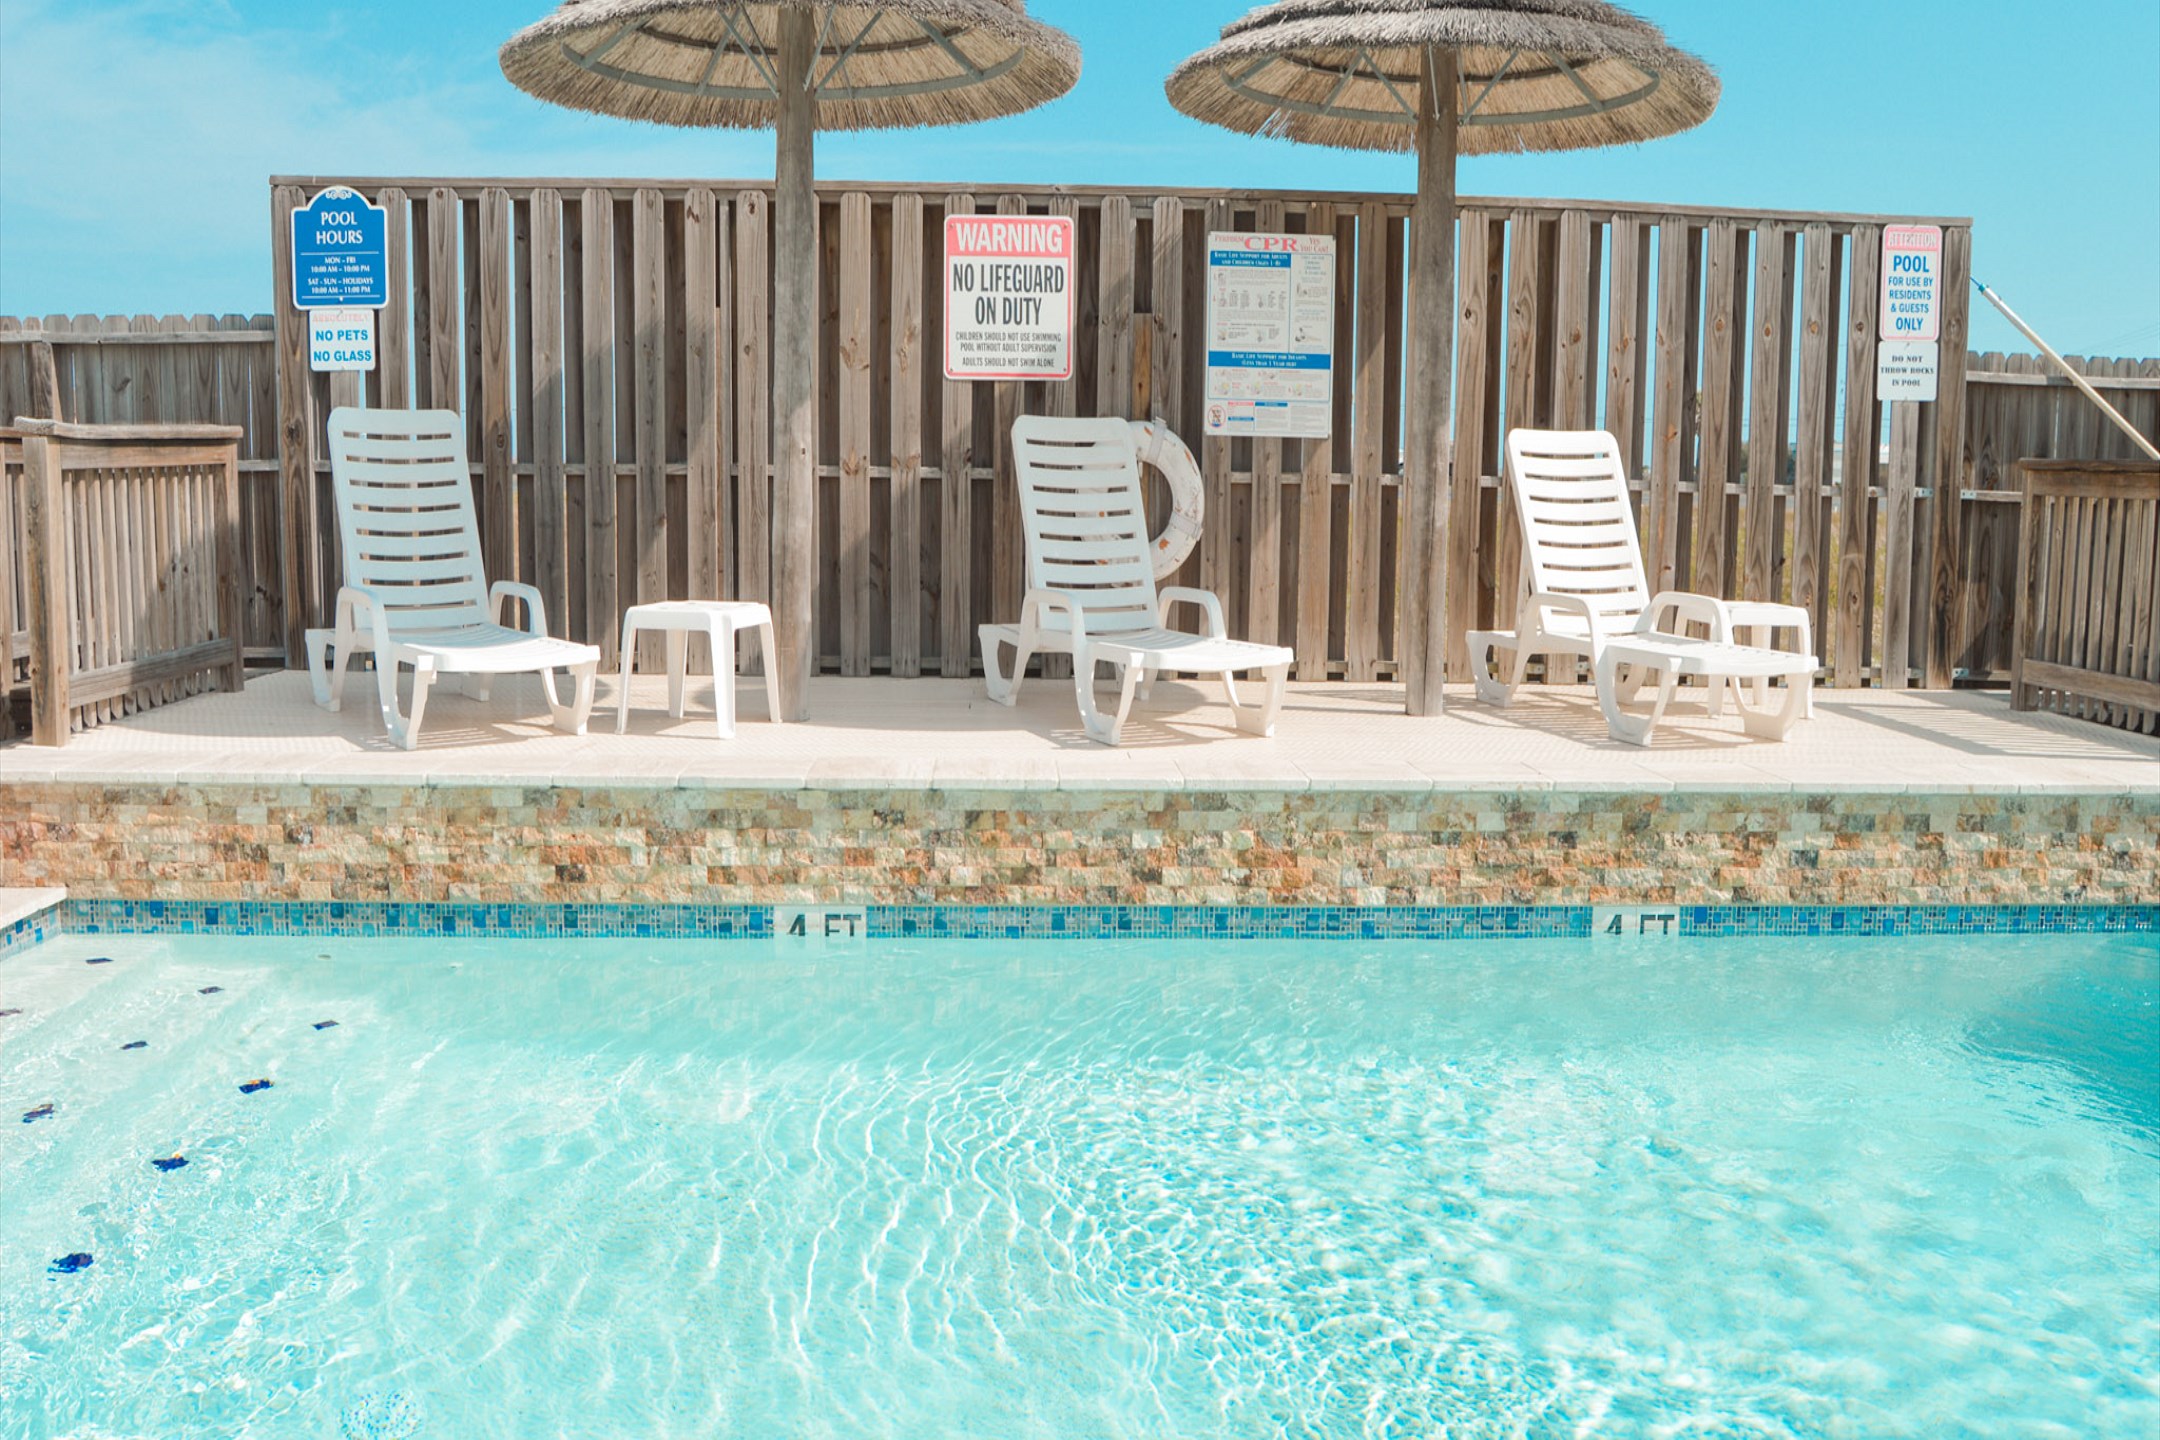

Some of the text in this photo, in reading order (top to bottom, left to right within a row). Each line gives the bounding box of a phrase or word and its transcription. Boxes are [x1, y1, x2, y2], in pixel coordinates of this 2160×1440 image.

[320, 211, 357, 226] POOL
[316, 230, 363, 244] HOURS
[955, 222, 1063, 253] WARNING
[1244, 236, 1299, 252] CPR
[1888, 232, 1936, 248] ATTENTION
[1893, 255, 1929, 272] POOL
[953, 263, 1064, 293] NO LIFEGUARD
[1888, 276, 1933, 287] FOR USE BY
[1889, 290, 1931, 300] RESIDENTS
[975, 296, 1042, 325] ON DUTY
[1891, 303, 1929, 313] & GUESTS
[1896, 317, 1924, 331] ONLY
[316, 330, 368, 341] NO PETS
[956, 332, 1061, 342] CHILDREN SHOULD NOT USE SWIMMING
[960, 343, 1056, 353] POOL WITHOUT ADULT SUPERVISION
[314, 350, 372, 361] NO GLASS
[962, 357, 1054, 367] ADULTS SHOULD NOT SWIM ALONE
[787, 914, 861, 936] 4 FT
[1604, 914, 1675, 935] 4 FT
